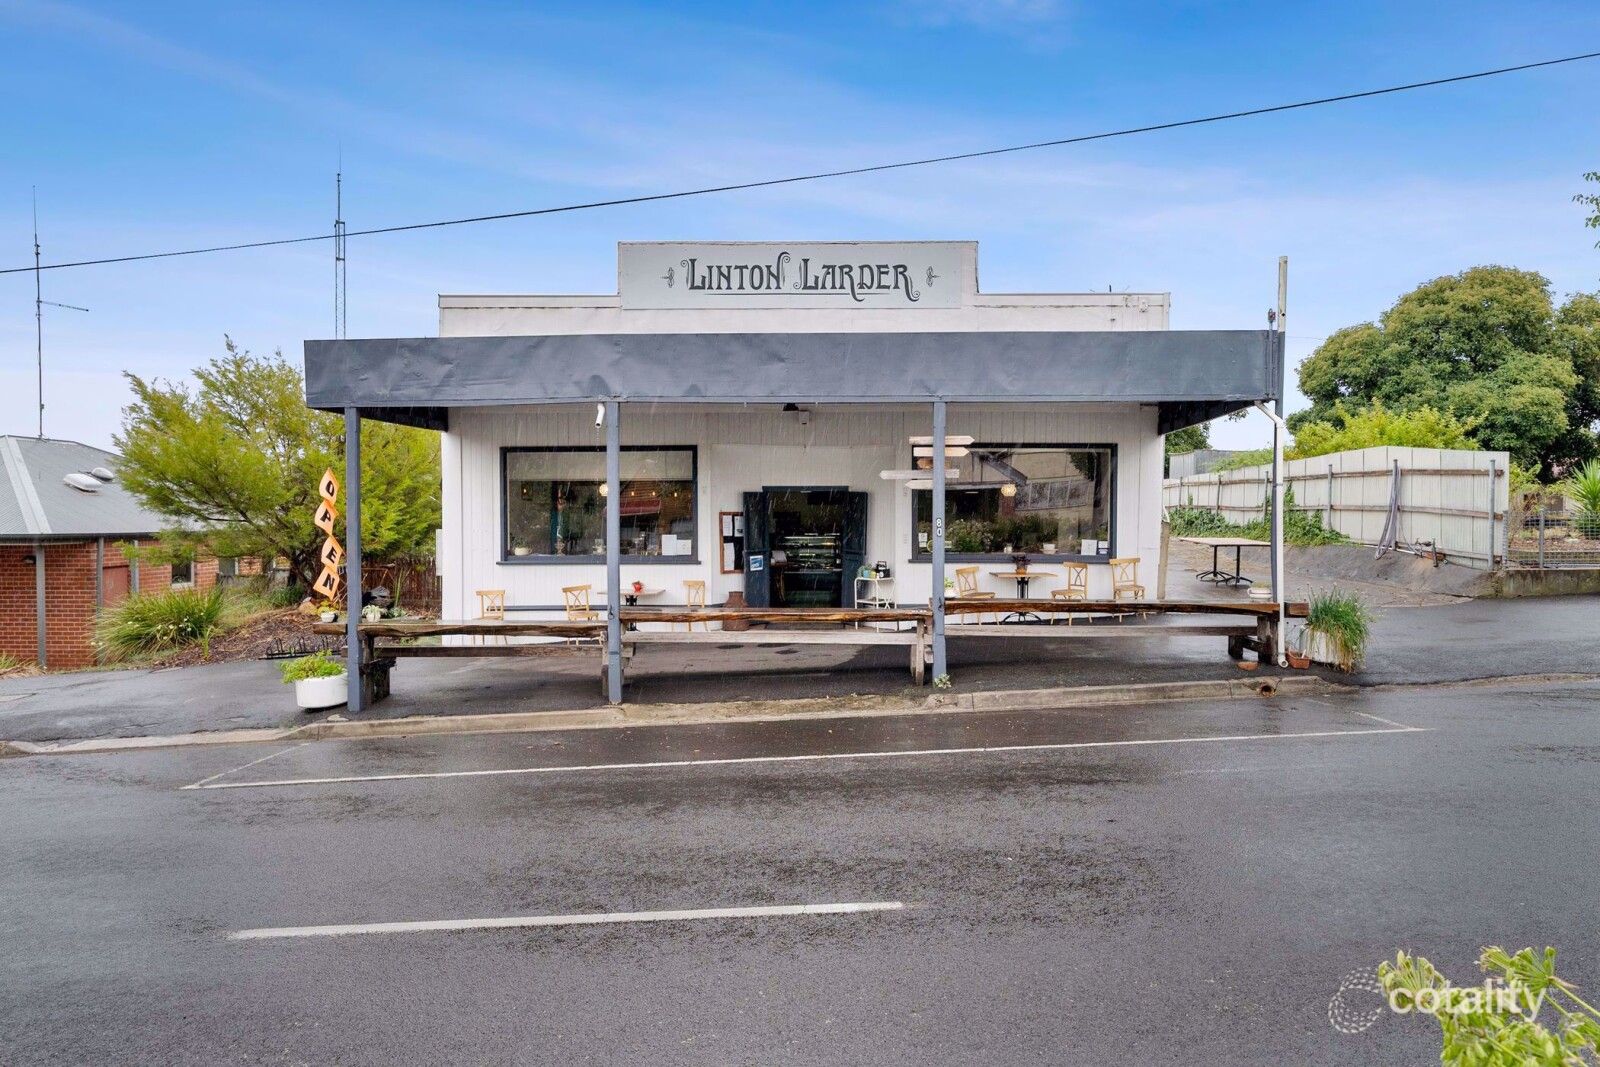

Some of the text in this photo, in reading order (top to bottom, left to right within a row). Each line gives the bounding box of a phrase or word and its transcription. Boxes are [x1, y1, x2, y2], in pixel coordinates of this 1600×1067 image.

[681, 252, 921, 301] LINTON LARDER
[320, 480, 337, 591] OPEN
[936, 518, 942, 537] 80
